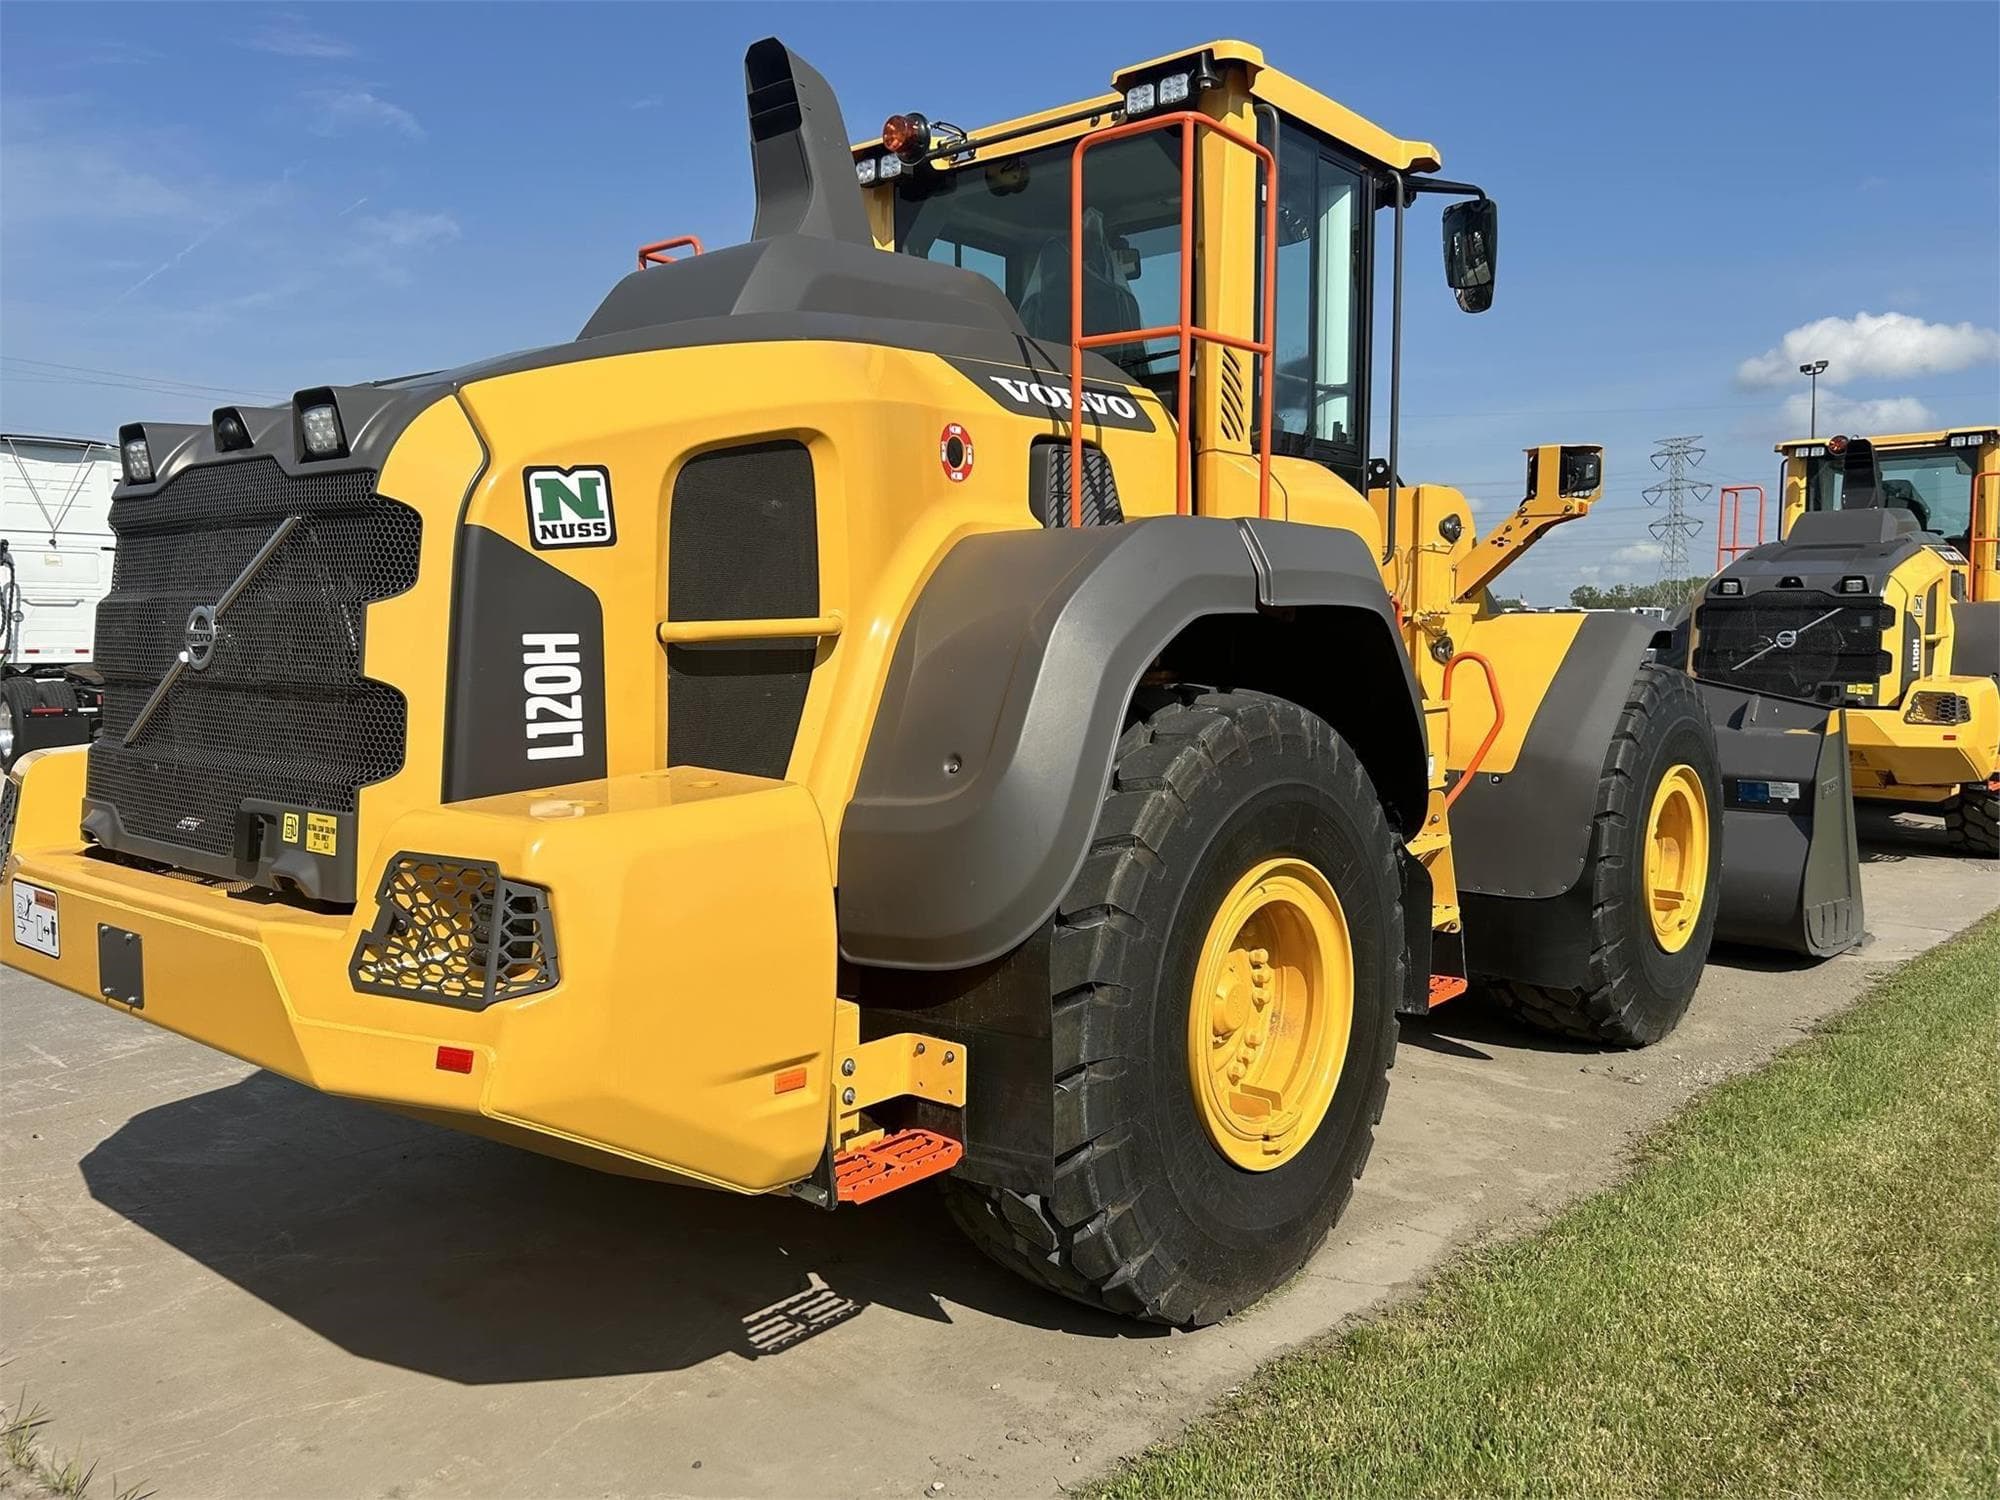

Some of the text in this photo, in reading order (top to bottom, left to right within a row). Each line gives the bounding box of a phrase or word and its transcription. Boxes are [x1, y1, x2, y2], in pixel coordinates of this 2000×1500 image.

[989, 376, 1136, 419] VOLVO
[534, 477, 605, 521] N
[540, 522, 607, 540] NUSS
[522, 633, 584, 760] L120H
